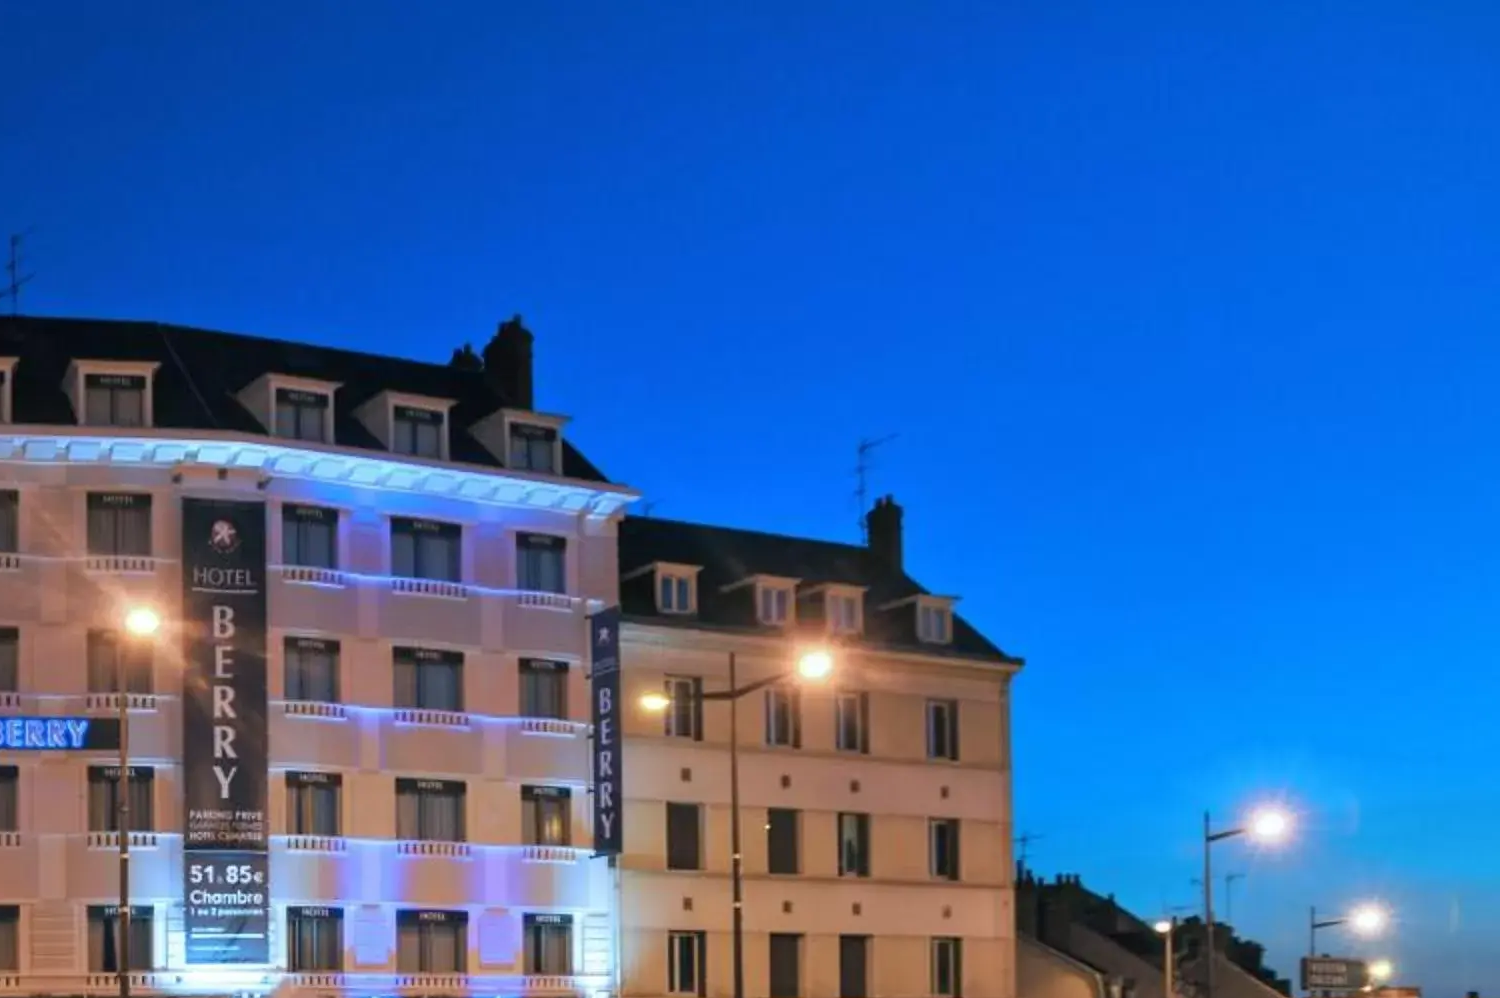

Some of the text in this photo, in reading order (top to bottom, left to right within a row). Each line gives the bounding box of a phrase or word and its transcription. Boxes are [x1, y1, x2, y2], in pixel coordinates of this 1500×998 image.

[193, 566, 257, 586] HOTEL
[212, 605, 239, 799] BERRY
[599, 687, 616, 839] BERRY
[190, 865, 214, 883] 51
[190, 889, 263, 905] Chambre
